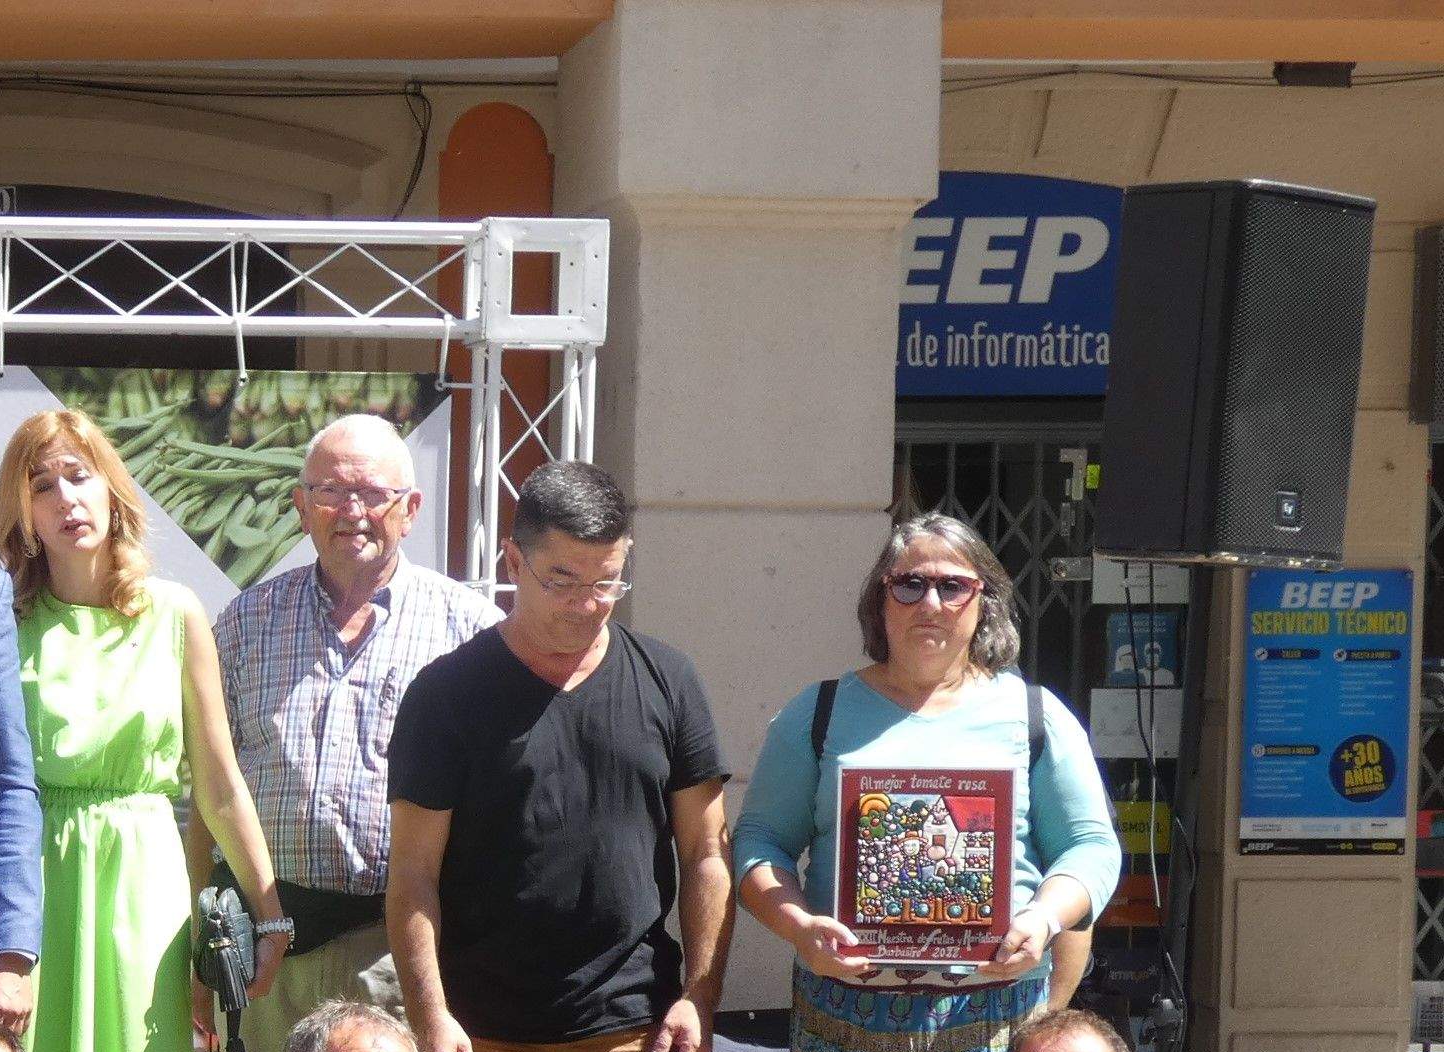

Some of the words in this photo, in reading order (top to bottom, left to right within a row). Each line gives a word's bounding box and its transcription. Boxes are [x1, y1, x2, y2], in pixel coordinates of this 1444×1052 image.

[899, 215, 1111, 304] EEP
[907, 320, 939, 367] de
[946, 320, 1110, 367] informática
[1280, 582, 1380, 609] BEEP
[1252, 611, 1330, 635] SERVICIO
[1336, 608, 1408, 635] TÉCNICO
[1341, 740, 1380, 768] +30
[910, 774, 952, 789] tomate
